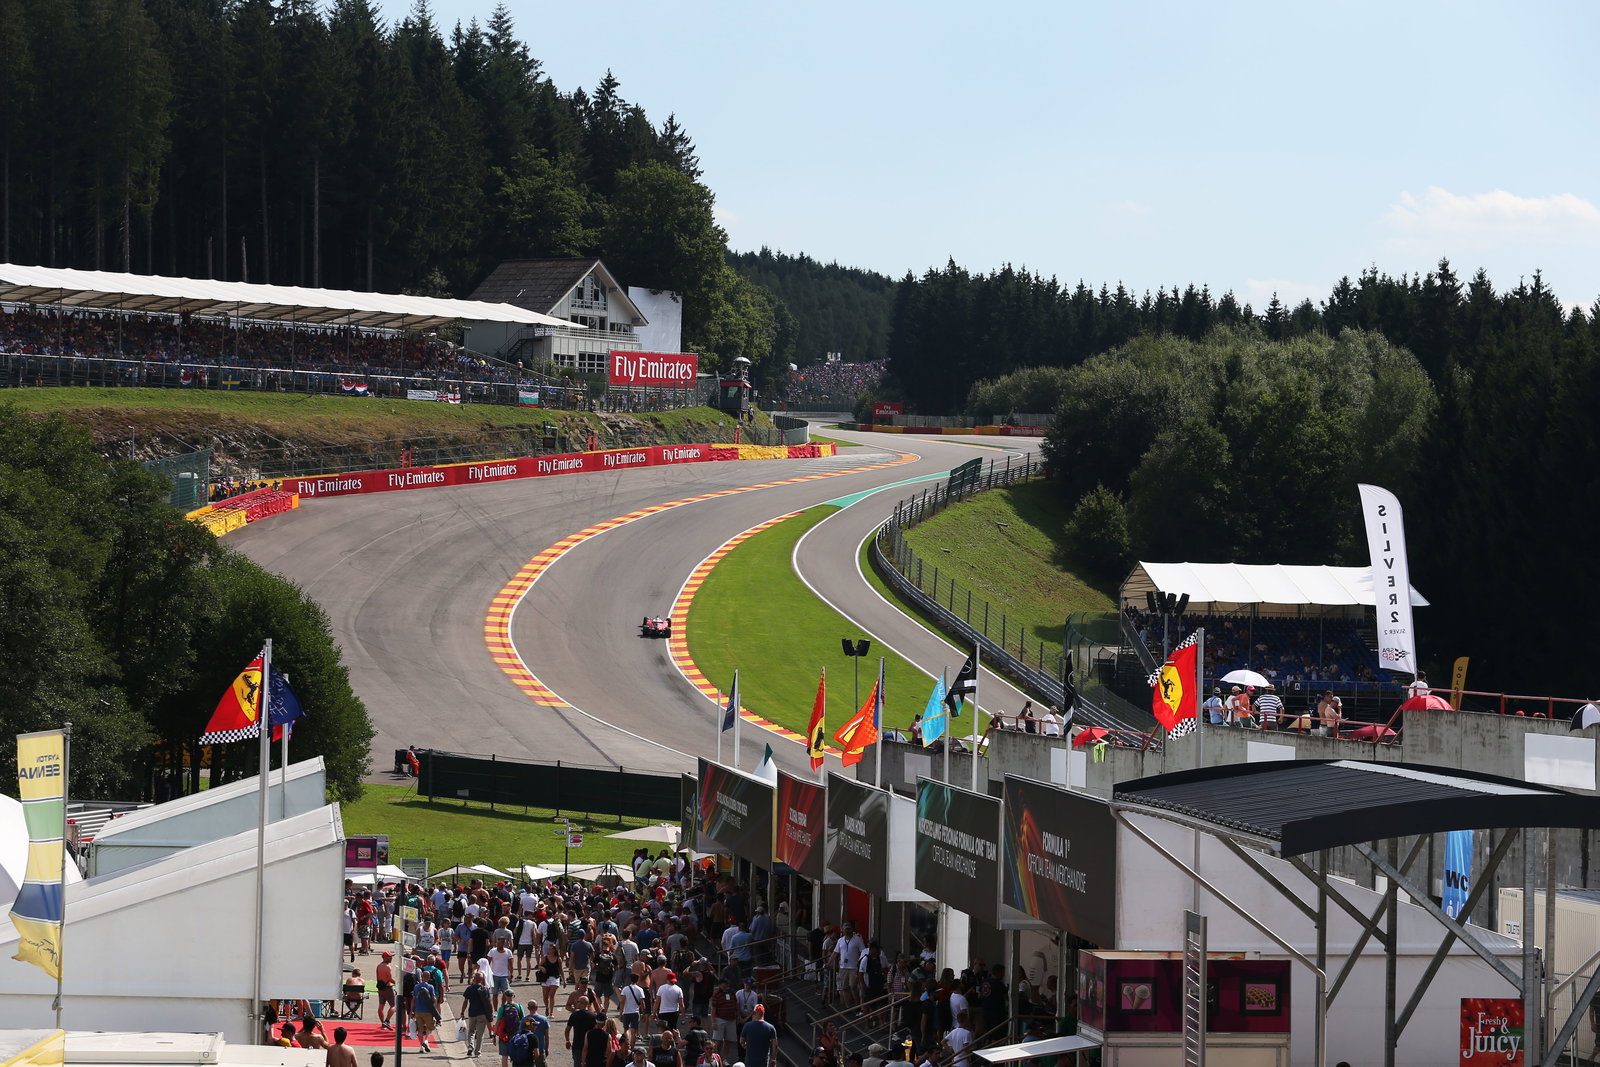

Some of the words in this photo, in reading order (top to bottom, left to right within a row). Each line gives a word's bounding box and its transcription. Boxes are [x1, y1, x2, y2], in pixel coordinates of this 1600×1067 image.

[614, 355, 636, 382] Fly
[638, 356, 693, 380] Emirates
[603, 453, 616, 468] Fly
[616, 451, 647, 465] Emirates
[663, 449, 674, 462] Fly
[674, 447, 701, 459] Emirates
[468, 466, 483, 480] Fly
[483, 464, 518, 478] Emirates
[537, 459, 552, 474] Fly
[552, 456, 584, 471] Emirates
[297, 481, 316, 496] Fly
[317, 478, 363, 493] Emirates
[388, 472, 405, 488] Fly
[406, 471, 445, 486] Emirates
[1042, 831, 1064, 858] FORMULA
[1027, 852, 1044, 877] OFFICIAL
[1445, 869, 1468, 892] WC
[1476, 1012, 1501, 1034] Fresh
[1500, 1017, 1511, 1035] &
[1462, 1026, 1521, 1061] Juicy
